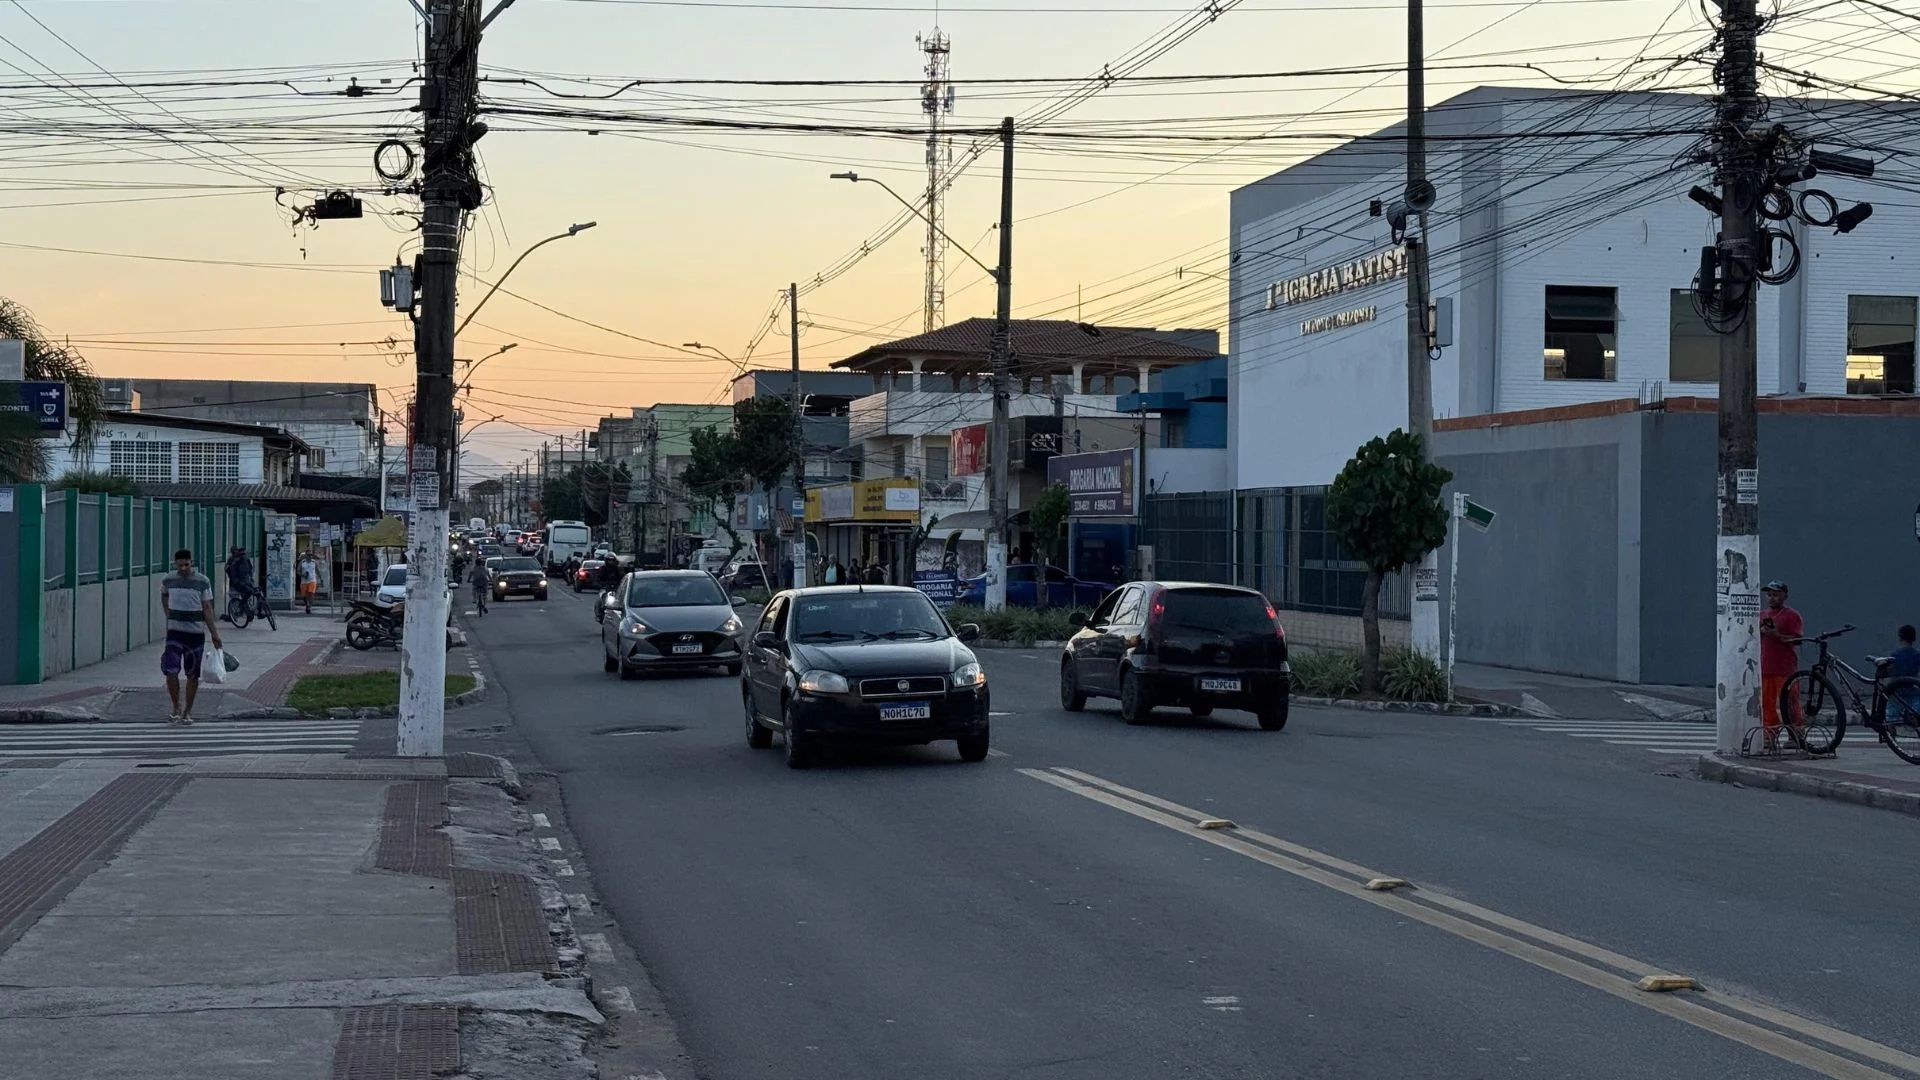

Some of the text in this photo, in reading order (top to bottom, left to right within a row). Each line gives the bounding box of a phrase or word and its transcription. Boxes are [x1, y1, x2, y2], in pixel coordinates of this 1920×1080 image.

[1284, 267, 1340, 303] IGREJA
[1343, 246, 1408, 285] BATIST
[1070, 467, 1095, 491] DROGARIA
[1096, 465, 1121, 490] NACIONAL
[916, 583, 953, 591] DROGARIA
